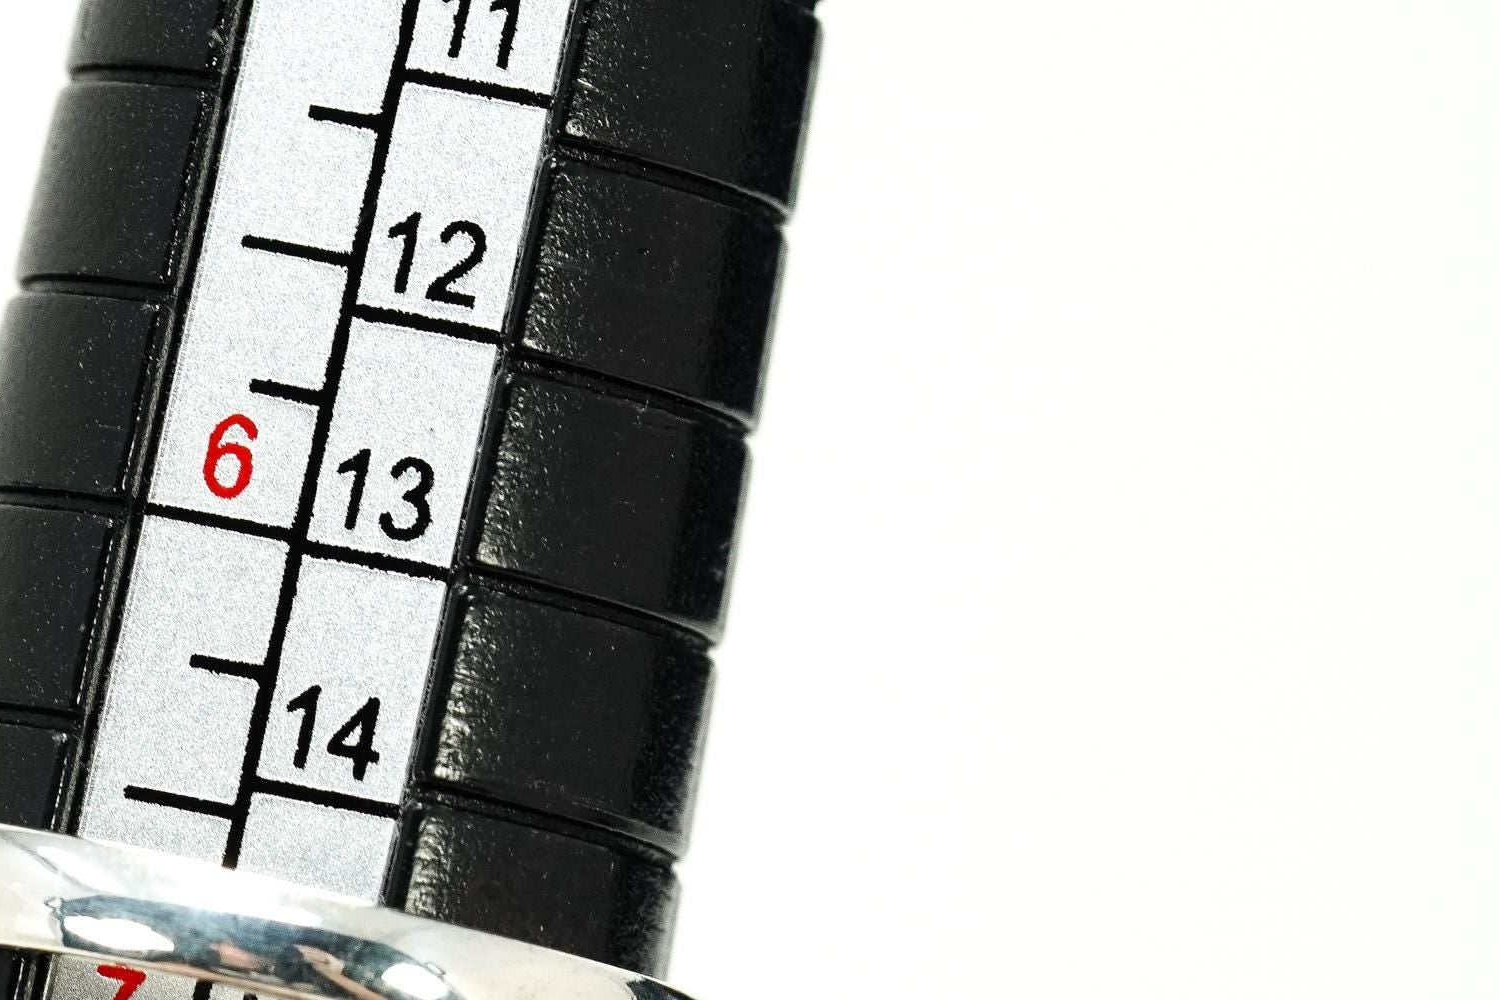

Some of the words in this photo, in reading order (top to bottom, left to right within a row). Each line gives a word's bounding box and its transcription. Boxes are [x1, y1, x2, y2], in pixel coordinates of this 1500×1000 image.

[441, 0, 521, 71] 11
[387, 211, 488, 310] 12
[202, 413, 259, 500] 6
[336, 448, 435, 543] 13
[286, 684, 382, 782] 14
